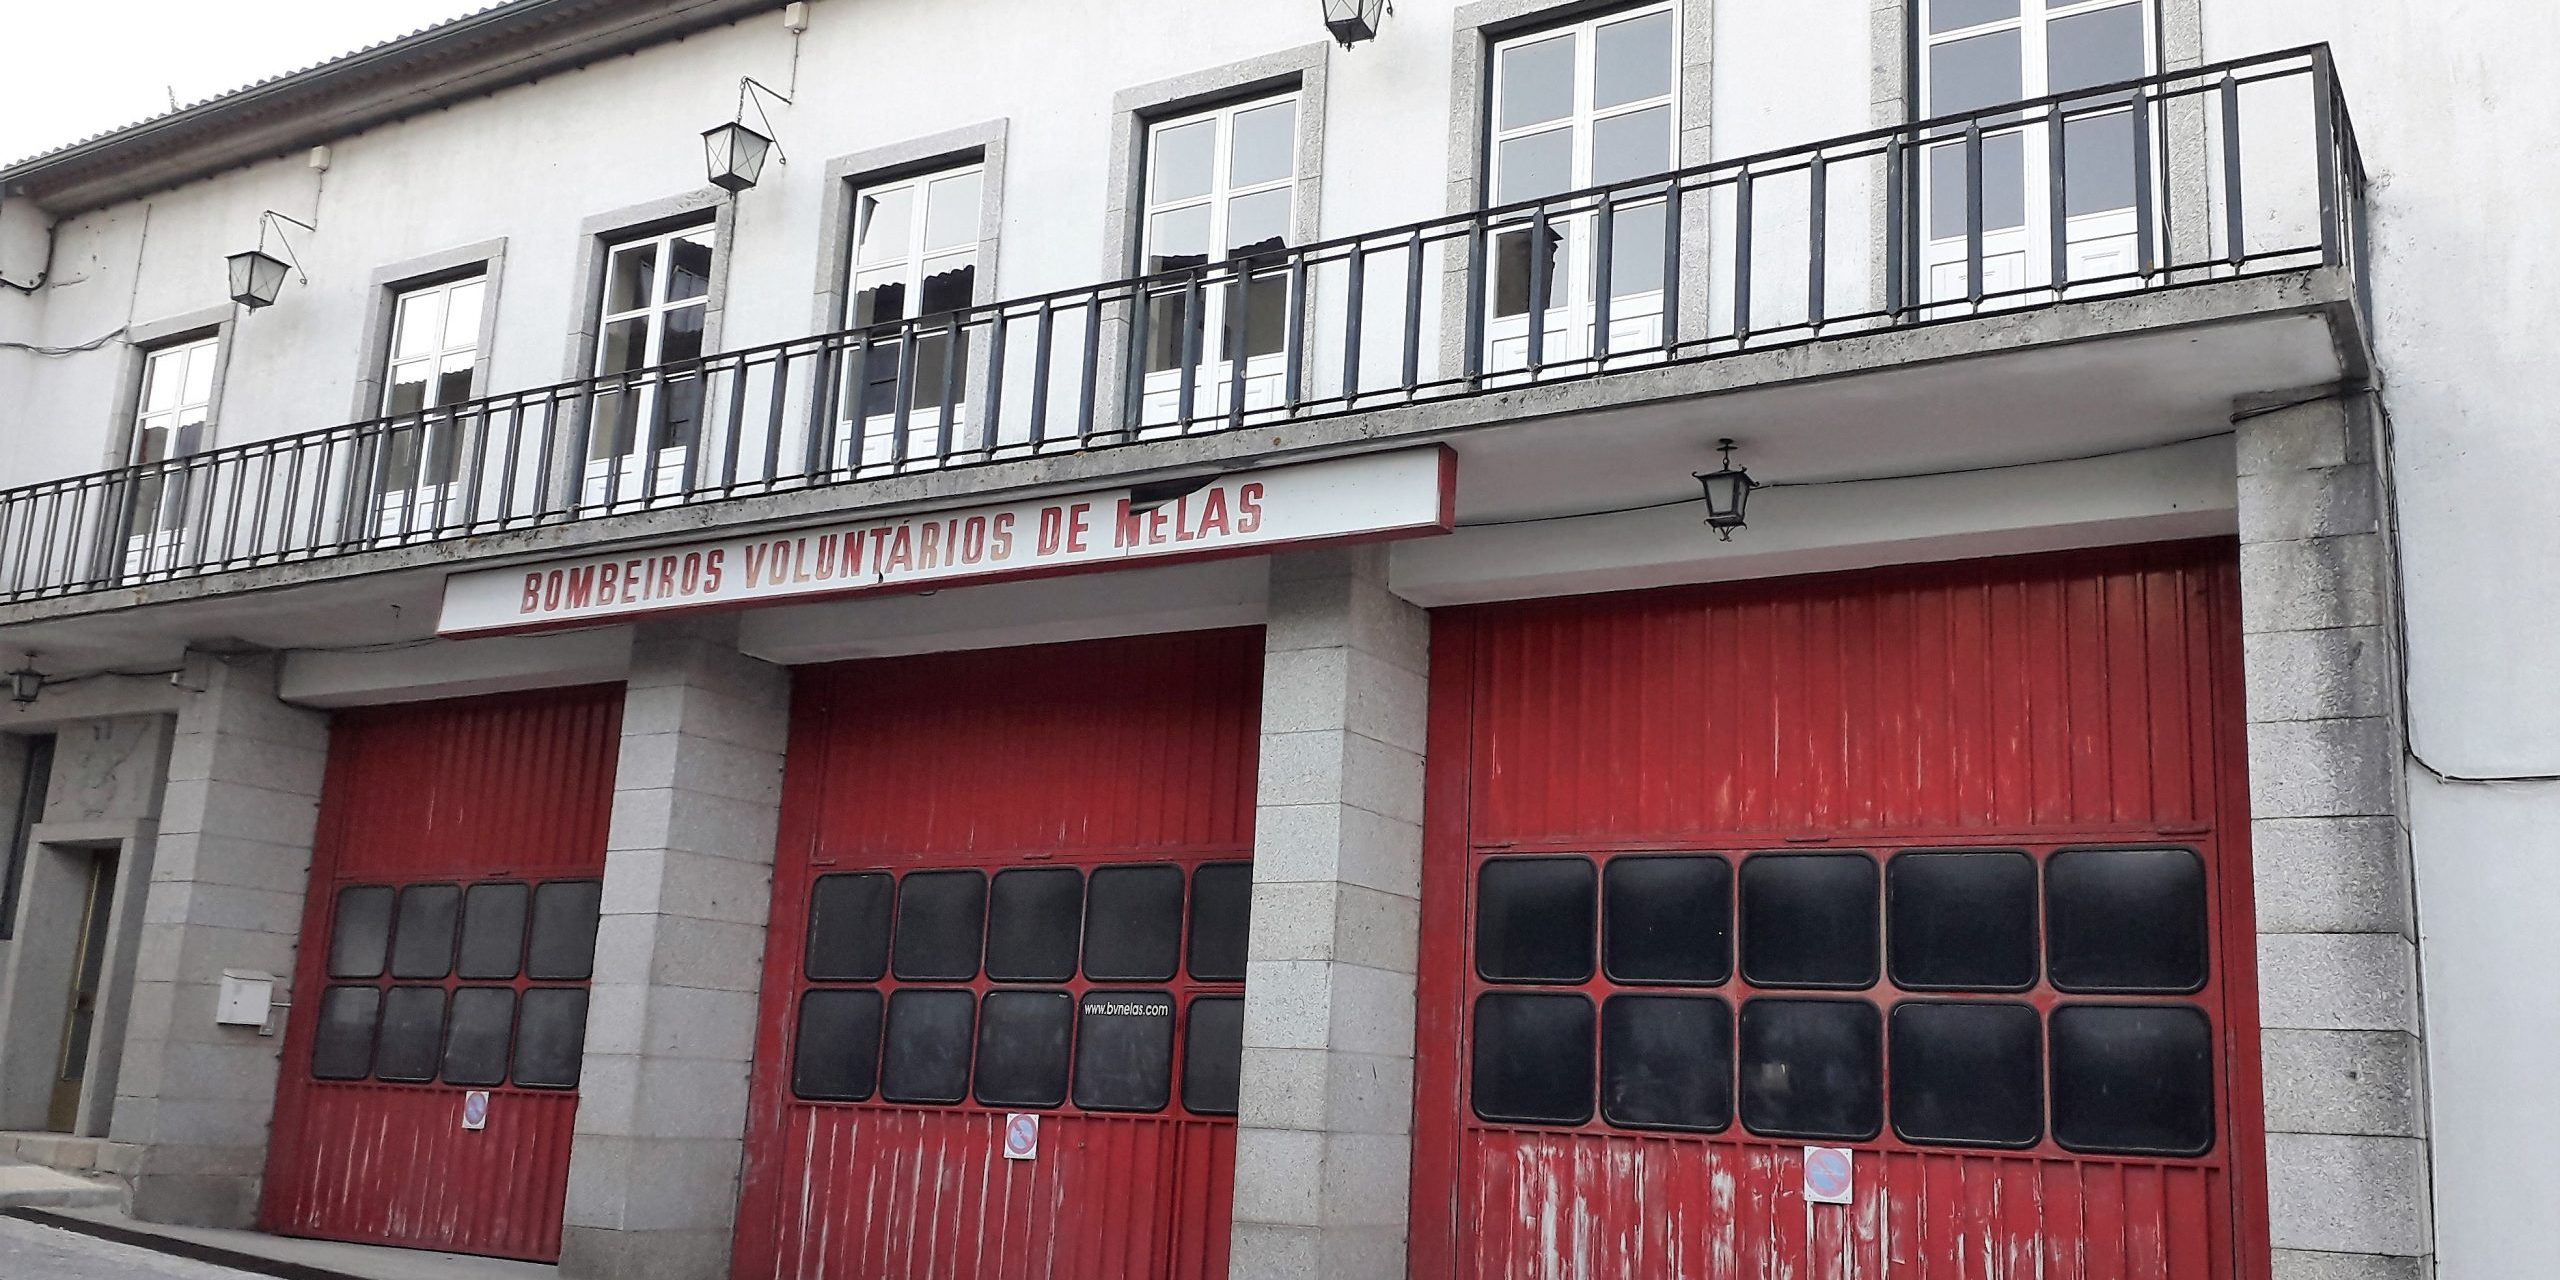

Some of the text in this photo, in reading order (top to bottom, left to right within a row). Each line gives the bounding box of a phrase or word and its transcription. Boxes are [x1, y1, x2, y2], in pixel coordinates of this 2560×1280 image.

[521, 482, 1264, 614] BOMBEIROS VOLUNTÁRIOS DE NELAS
[1084, 1002, 1168, 1016] www.bvnelas.com
